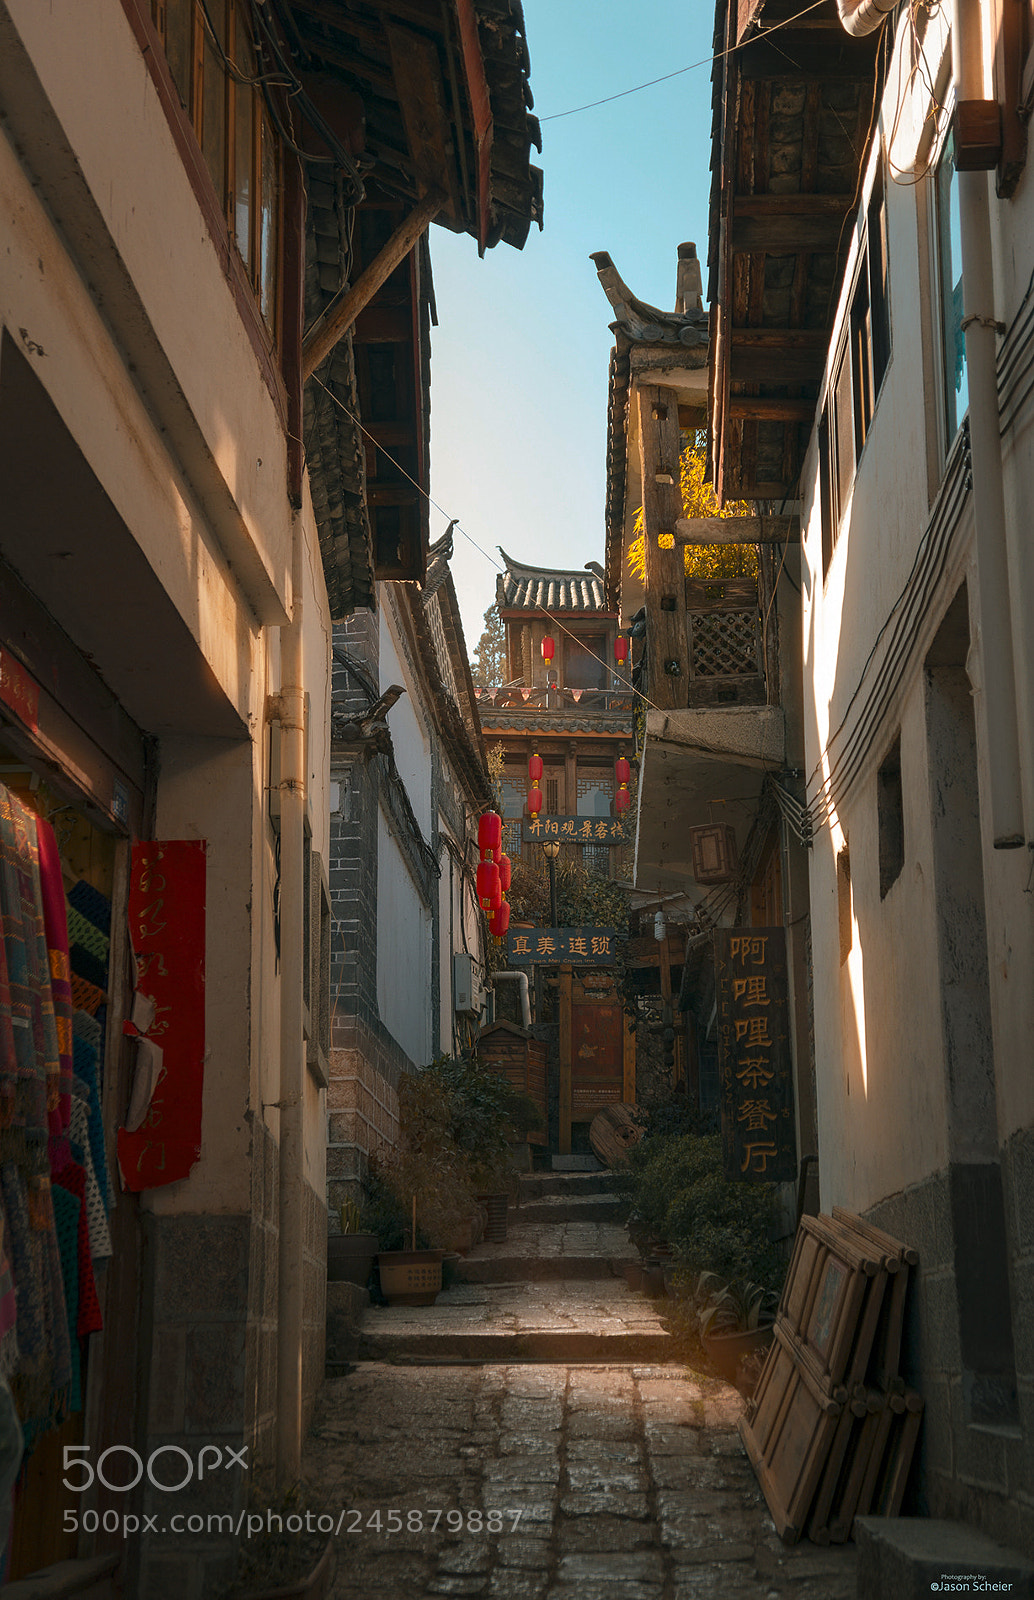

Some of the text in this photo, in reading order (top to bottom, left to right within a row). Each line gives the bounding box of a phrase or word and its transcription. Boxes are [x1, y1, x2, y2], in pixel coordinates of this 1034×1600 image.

[528, 818, 626, 840] 开阳观景客栈
[730, 936, 778, 1173] 啊哩哩茶餐厅
